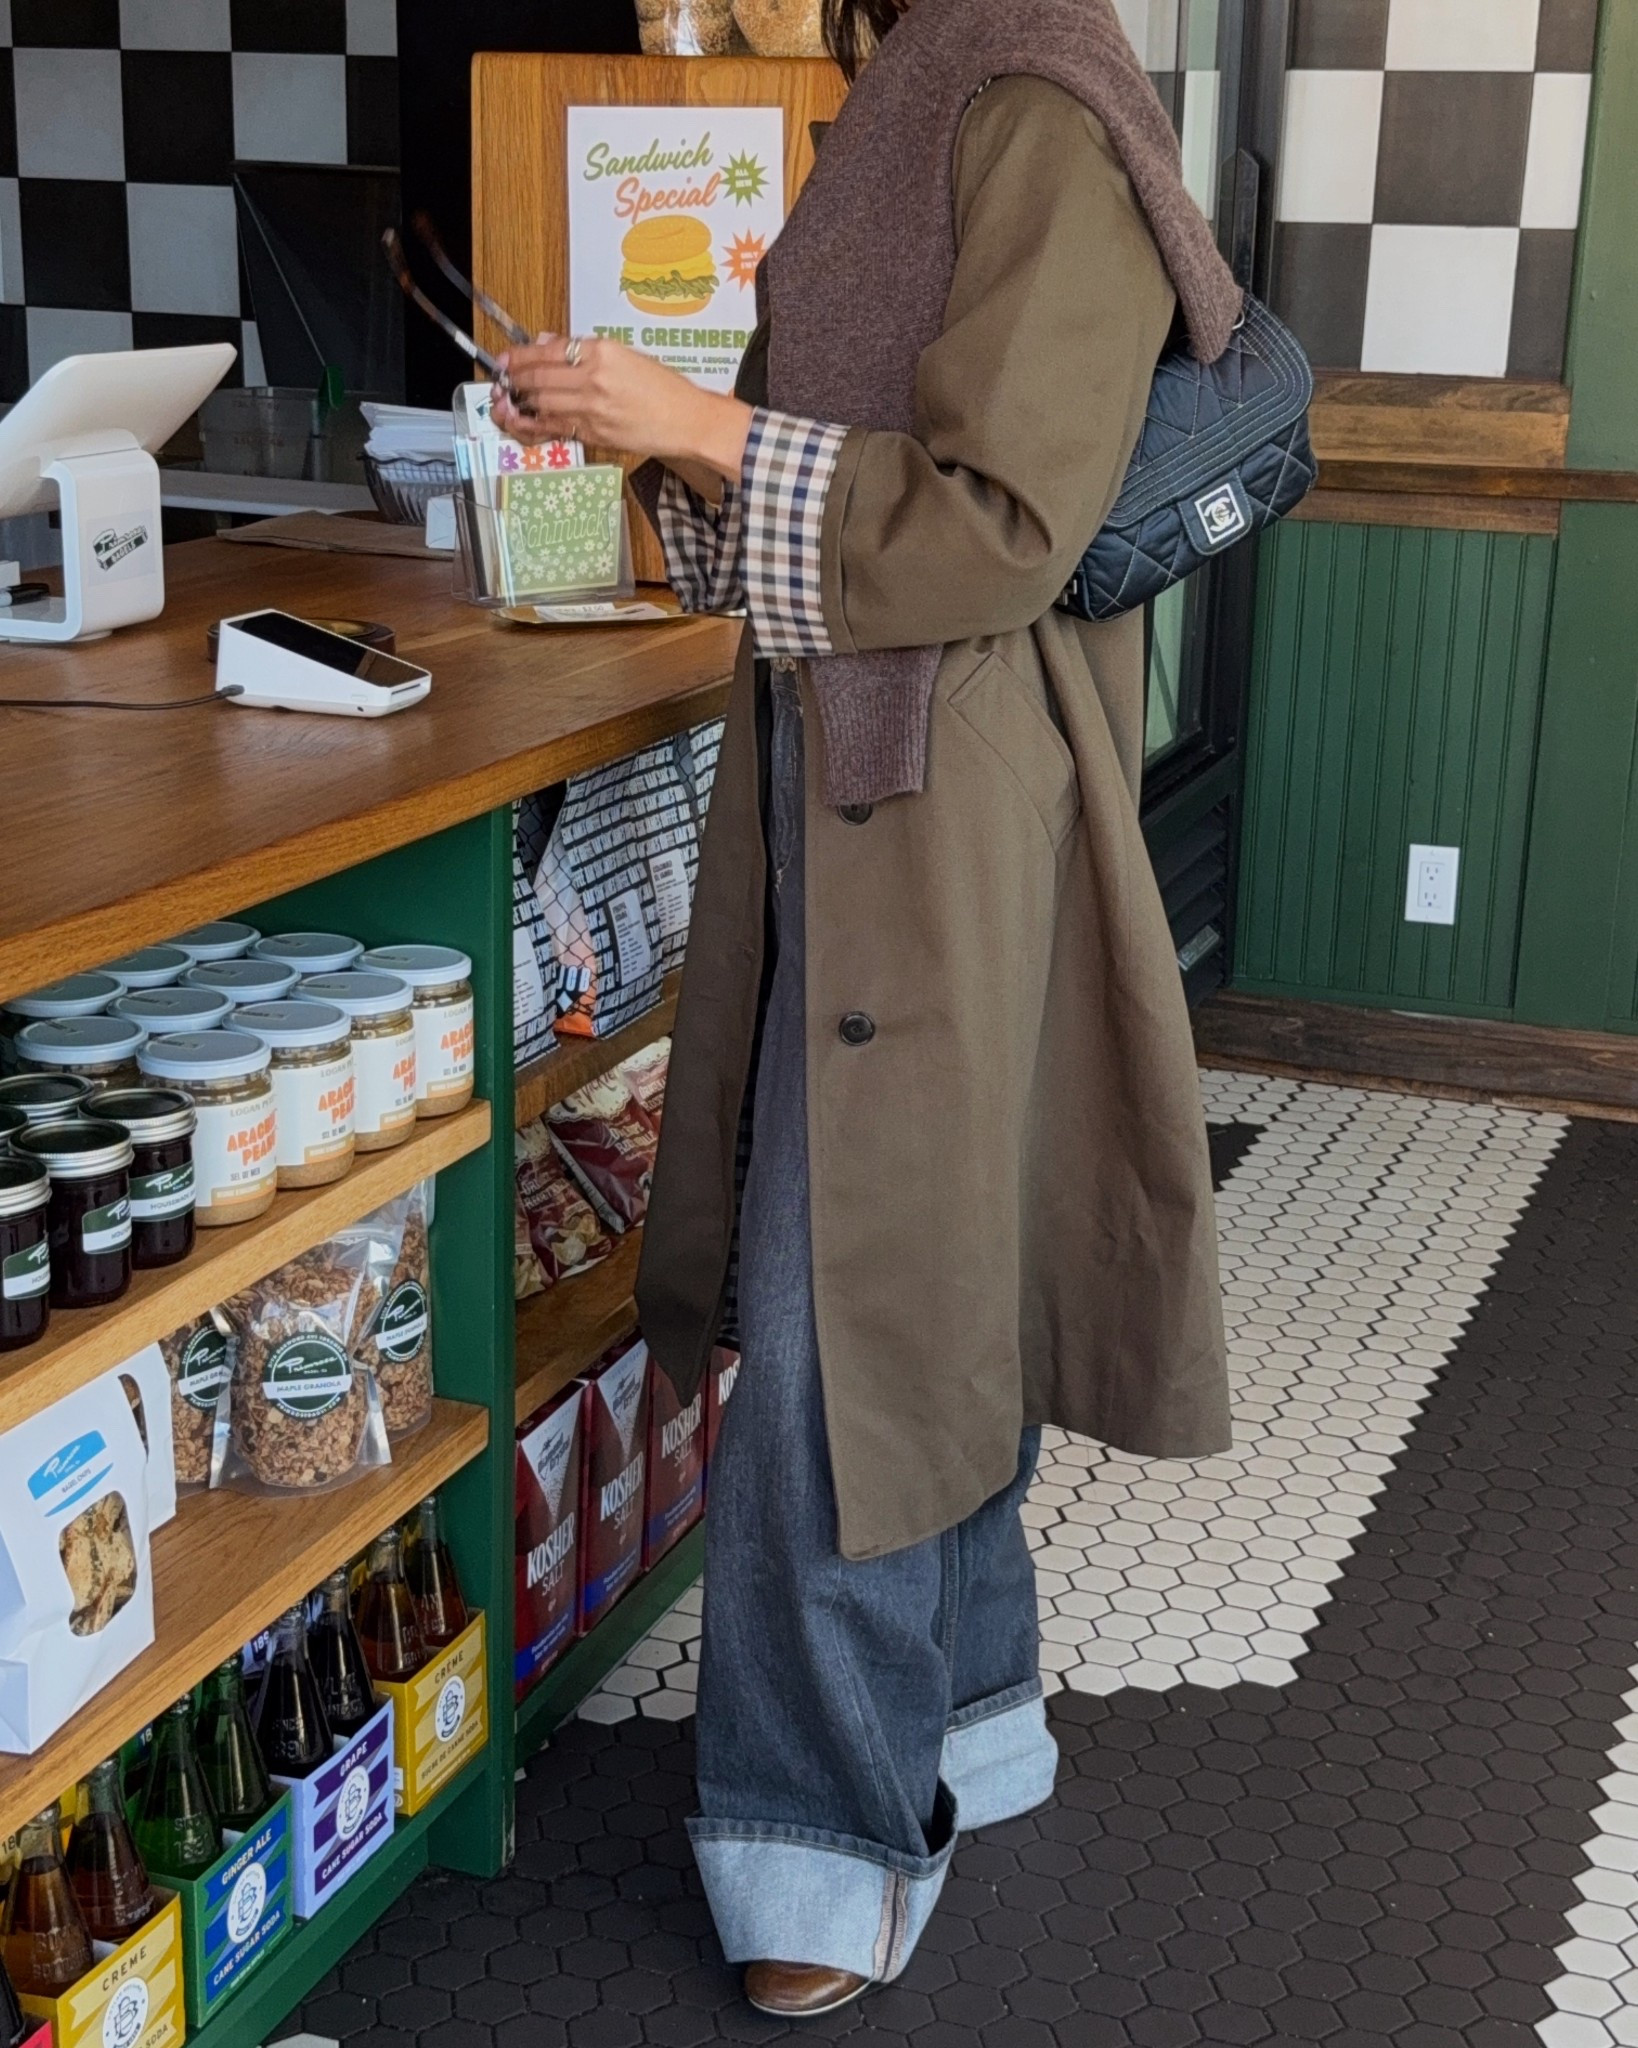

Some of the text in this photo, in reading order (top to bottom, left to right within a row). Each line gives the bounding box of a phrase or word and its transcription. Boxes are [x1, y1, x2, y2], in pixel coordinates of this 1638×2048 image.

[584, 131, 714, 181] Sandwich
[614, 172, 721, 224] Special
[593, 326, 634, 346] THE
[704, 367, 729, 375] MAYO
[277, 1380, 341, 1393] MAPLE GRANOLA
[661, 1392, 702, 1459] KOSHER
[673, 1435, 694, 1467] SALT
[601, 1451, 644, 1522] KOSHER
[614, 1496, 635, 1530] SALT
[527, 1511, 575, 1589] KOSHER
[541, 1559, 565, 1596] SALT
[340, 1741, 368, 1777] GRAPE
[222, 1828, 272, 1885] GINGER ALE
[321, 1855, 341, 1880] CANE
[342, 1832, 364, 1859] SUGAR
[365, 1812, 383, 1834] SODA
[103, 1946, 147, 1991] CREME
[213, 1959, 234, 1985] CANE
[235, 1934, 260, 1964] SUGAR
[261, 1910, 280, 1936] SODA
[145, 2024, 169, 2047] SODA
